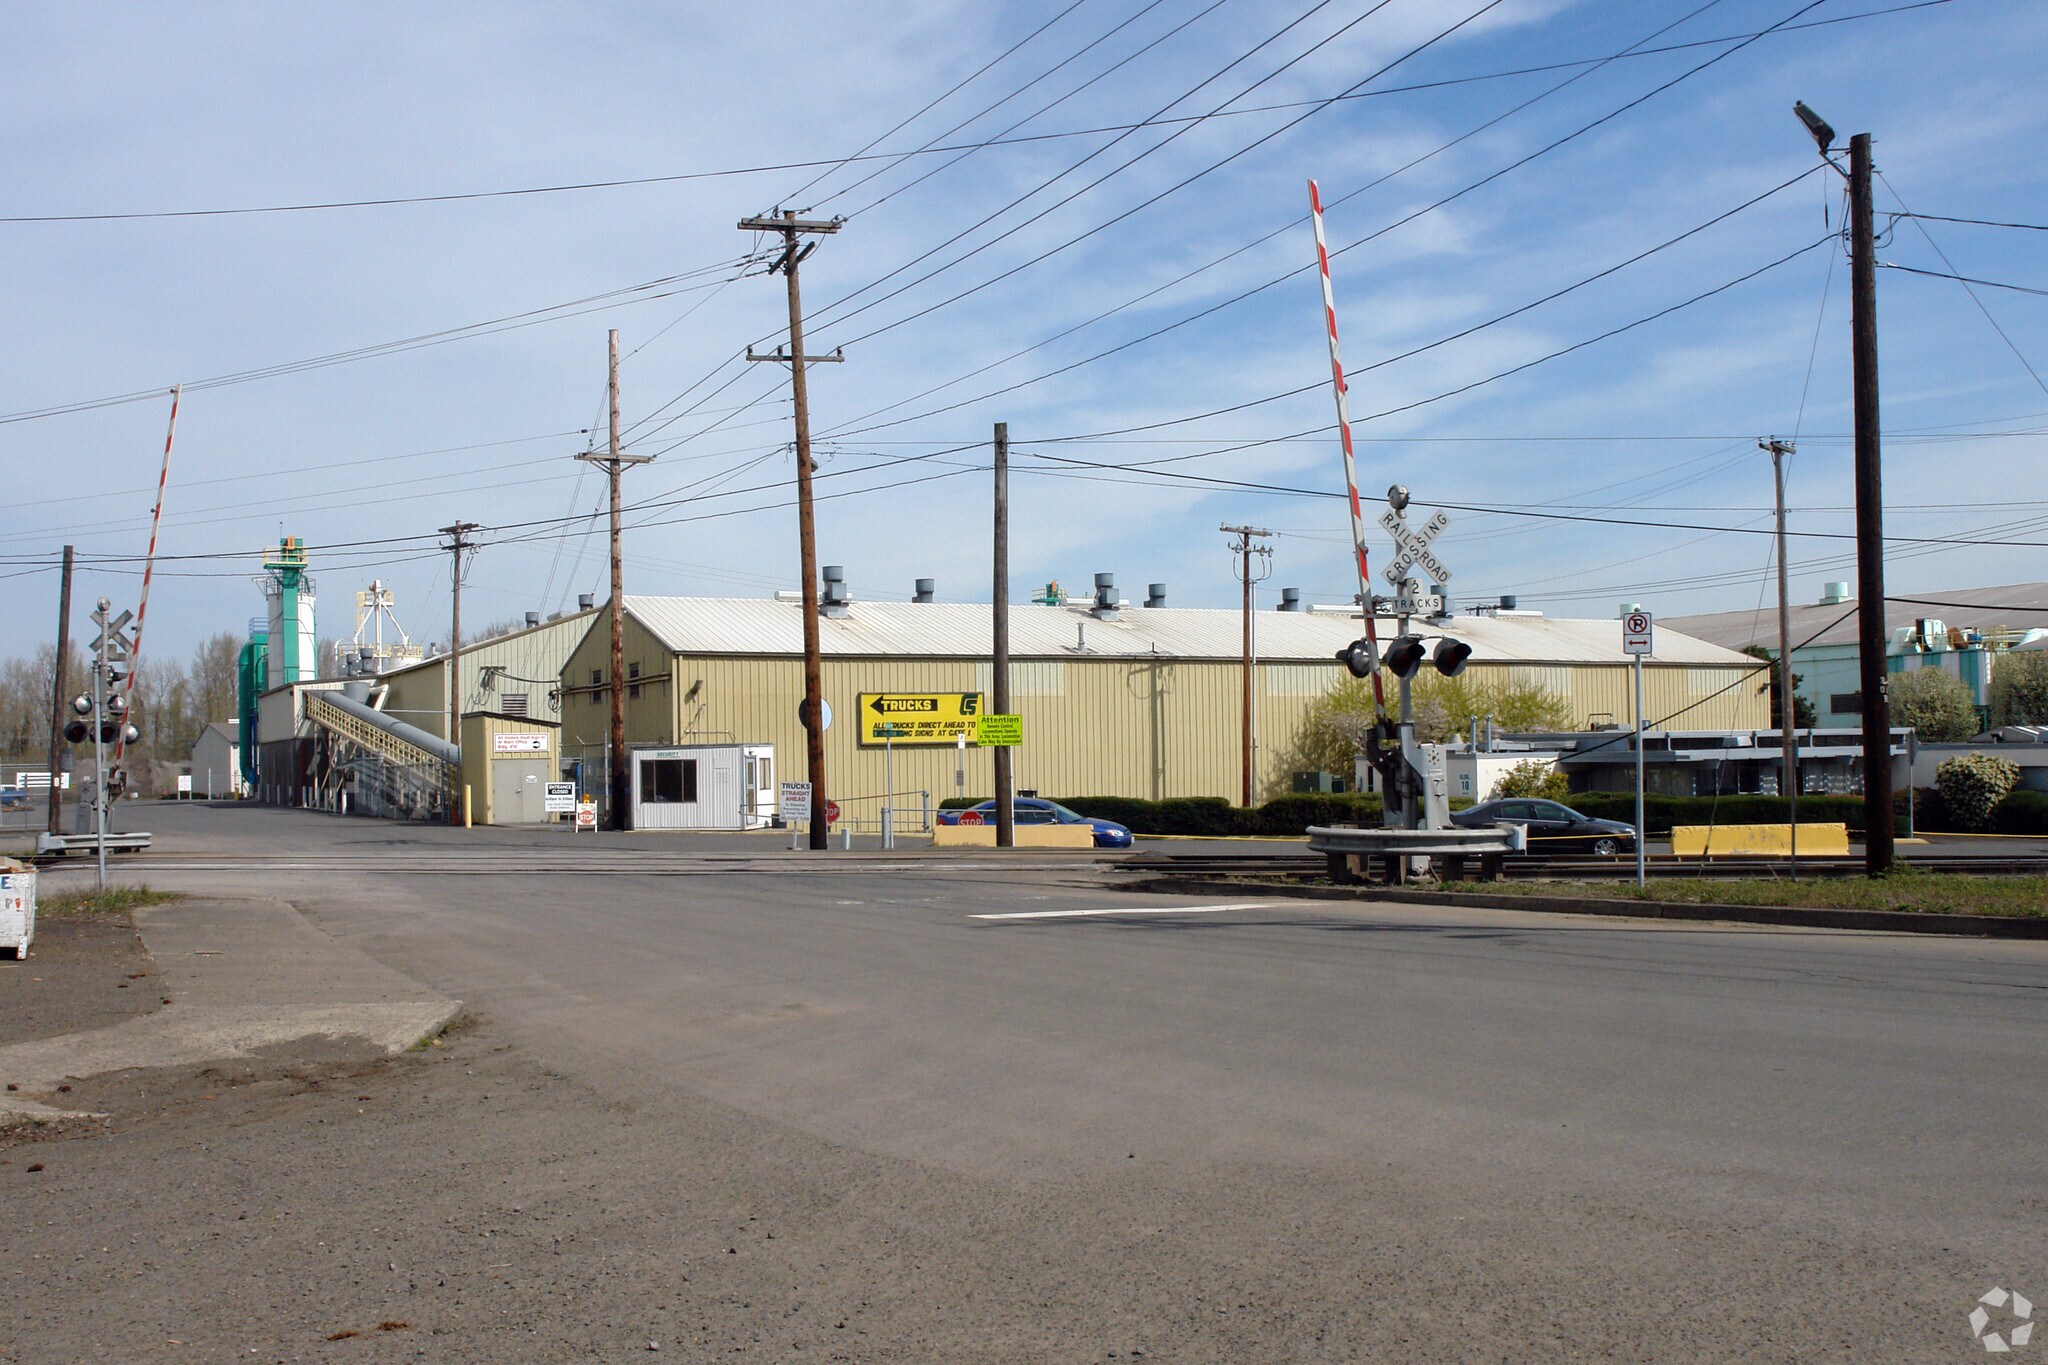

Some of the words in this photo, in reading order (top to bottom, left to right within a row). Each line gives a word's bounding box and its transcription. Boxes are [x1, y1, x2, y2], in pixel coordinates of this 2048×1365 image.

[1383, 513, 1411, 546] RAIL
[1419, 551, 1448, 582] ROAD
[1386, 514, 1447, 582] CROSSING
[1411, 582, 1420, 594] 2
[1393, 599, 1439, 609] TRACKS
[881, 699, 932, 711] TRUCKS
[891, 721, 915, 729] RUCKS
[918, 721, 941, 729] DIRECT
[1461, 780, 1470, 791] 10
